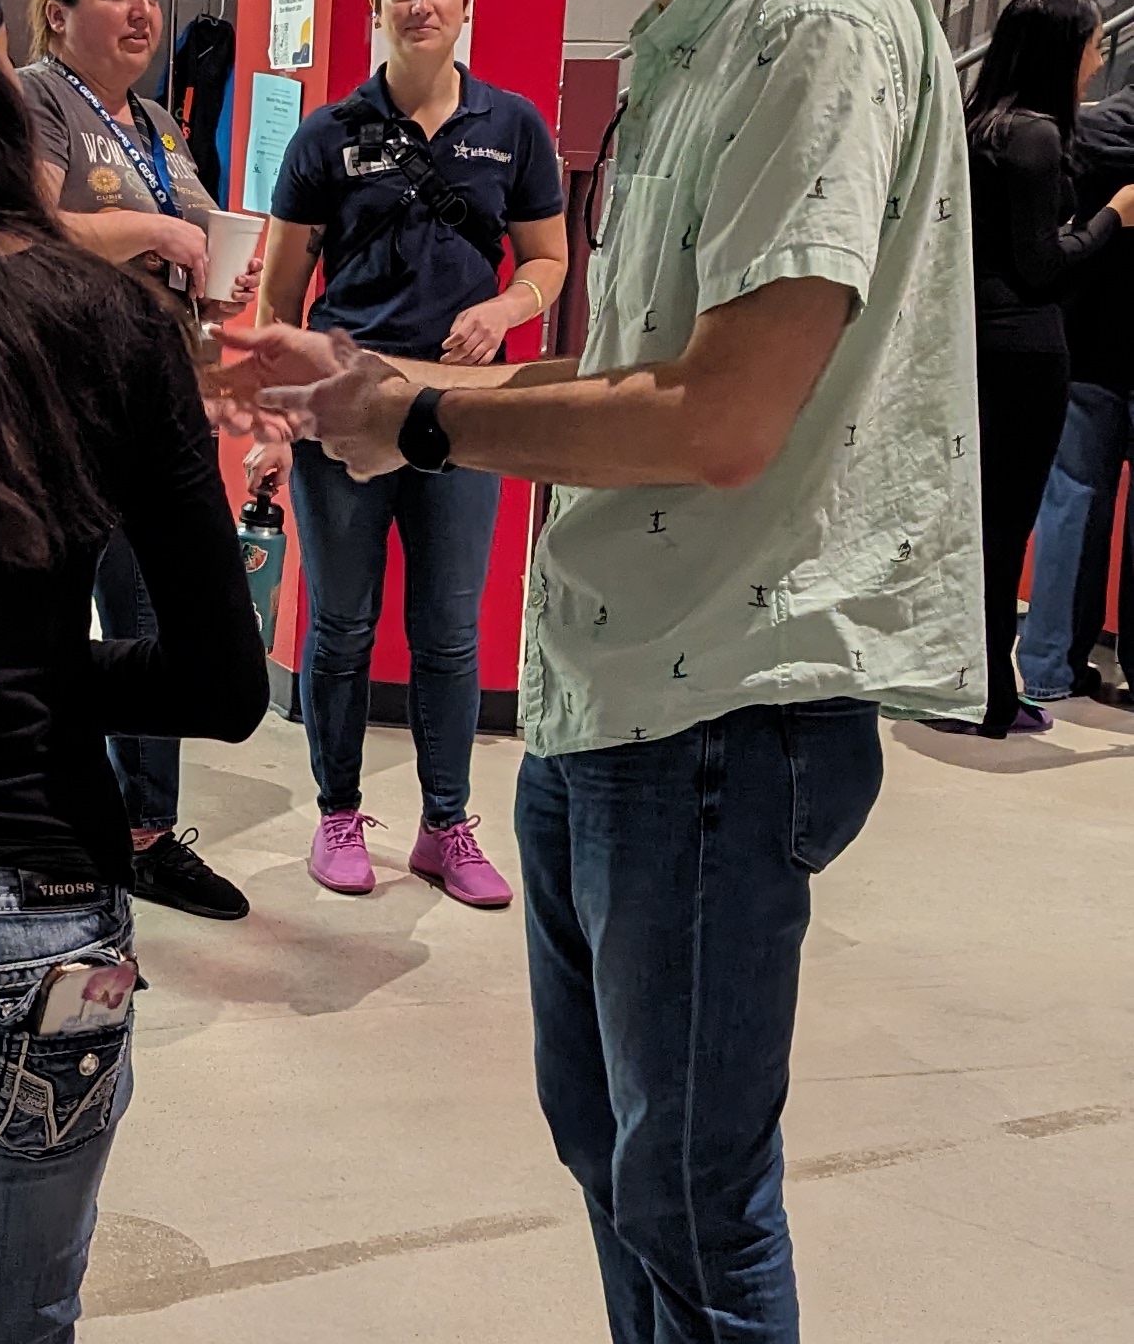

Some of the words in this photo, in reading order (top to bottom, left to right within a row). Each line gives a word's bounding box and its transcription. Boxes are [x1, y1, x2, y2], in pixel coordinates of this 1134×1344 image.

[78, 85, 103, 109] GEMS
[110, 122, 131, 148] GEMS
[138, 162, 159, 189] GEMS
[39, 882, 95, 896] VIGOSS
